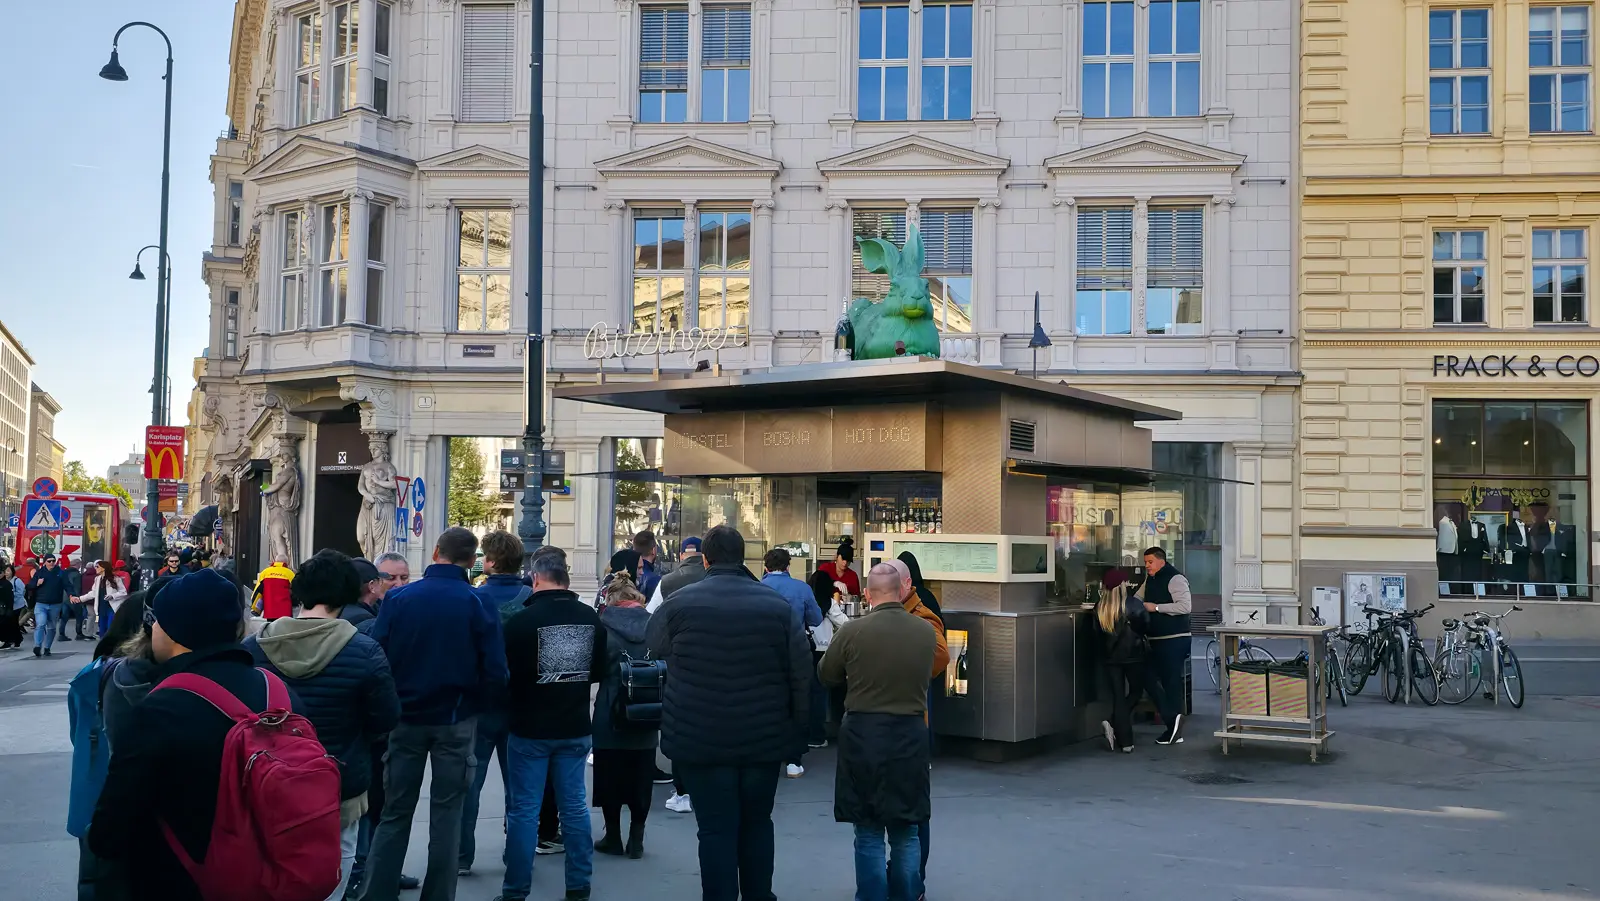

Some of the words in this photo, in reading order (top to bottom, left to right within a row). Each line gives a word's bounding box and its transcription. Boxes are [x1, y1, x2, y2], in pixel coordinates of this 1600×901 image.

[584, 321, 745, 367] Bitzinger
[1433, 354, 1518, 377] FRACK
[1527, 355, 1547, 377] &
[1555, 354, 1600, 377] CO
[148, 433, 182, 441] Karlsplatz
[673, 432, 733, 449] WÜRSTEL
[763, 430, 811, 446] BOSNA
[845, 428, 875, 444] HOT
[879, 426, 910, 443] DOG
[1479, 486, 1516, 497] FRACK
[1531, 487, 1551, 498] CO
